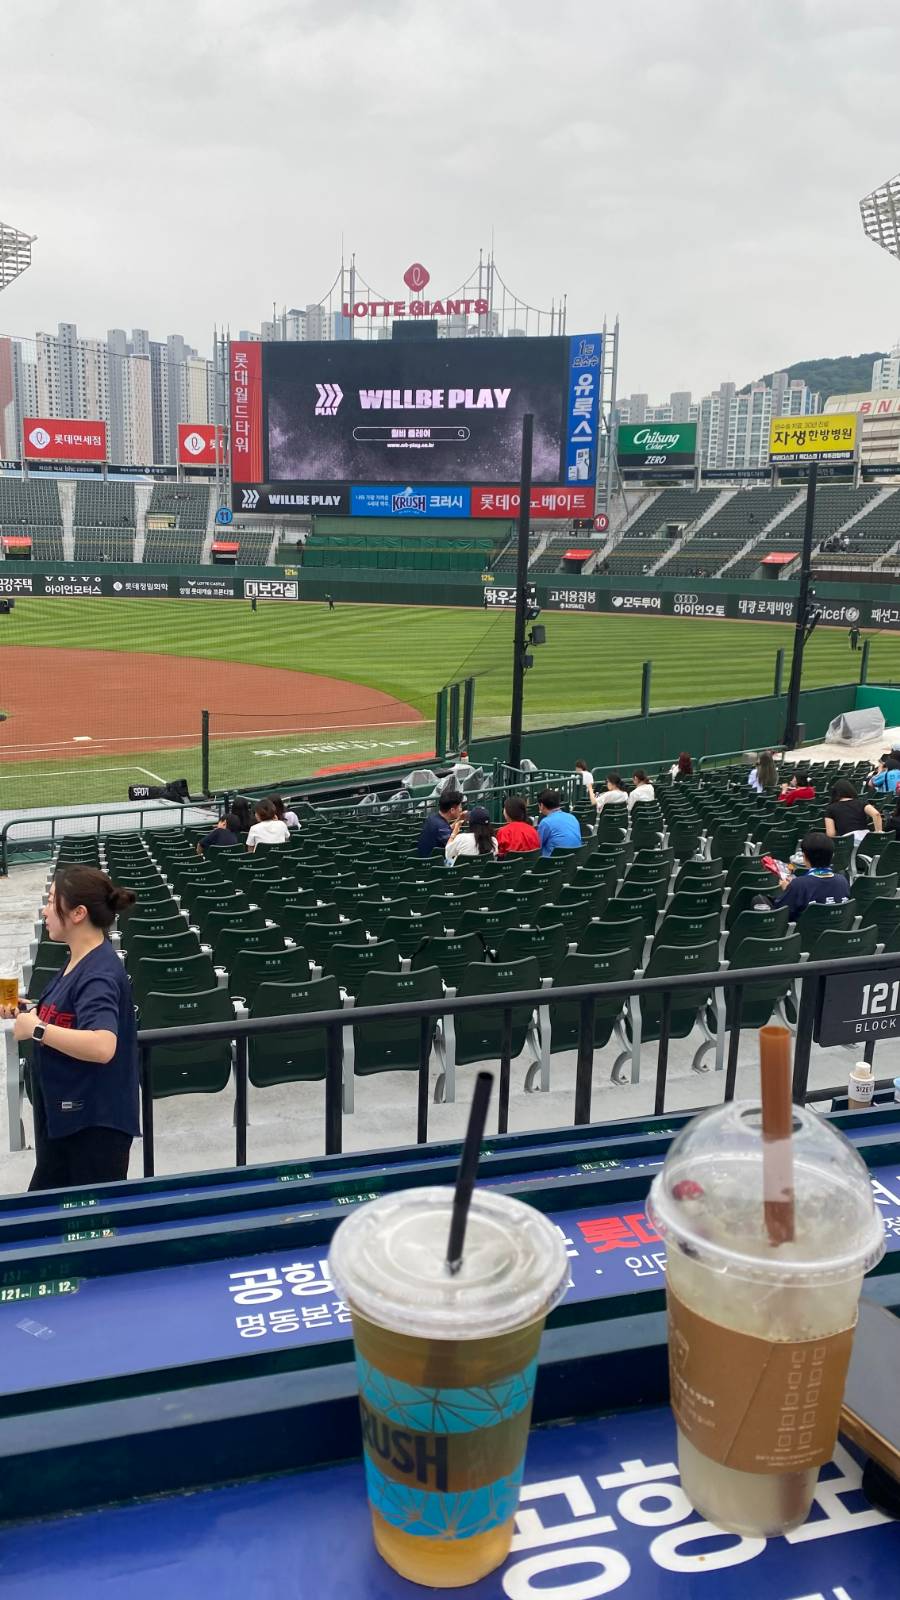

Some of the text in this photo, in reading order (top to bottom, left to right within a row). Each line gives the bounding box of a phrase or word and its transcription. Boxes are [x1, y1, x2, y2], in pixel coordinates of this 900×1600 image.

[342, 299, 489, 318] LOTTE GIANTS
[233, 352, 250, 453] 롯데월드타워
[358, 388, 511, 409] WILLBE PLAY
[315, 407, 338, 416] PLAY
[571, 373, 594, 442] 유록스
[54, 433, 102, 446] 롯데면세점
[633, 428, 680, 449] Chilsung
[773, 427, 852, 446] 자생한방병원
[644, 455, 667, 465] ZERO
[268, 494, 341, 506] WILLBE PLAY
[391, 494, 427, 513] KRUSH
[429, 495, 463, 508] 크러시
[596, 518, 606, 527] 10
[45, 584, 102, 595] 아이언모터스
[245, 582, 297, 598] 대보건설
[549, 590, 597, 604] 고려용접봉
[623, 596, 661, 609] 모두투어
[673, 603, 726, 617] 아이언오토
[861, 980, 900, 1016] 121
[855, 1018, 897, 1034] BLOCK
